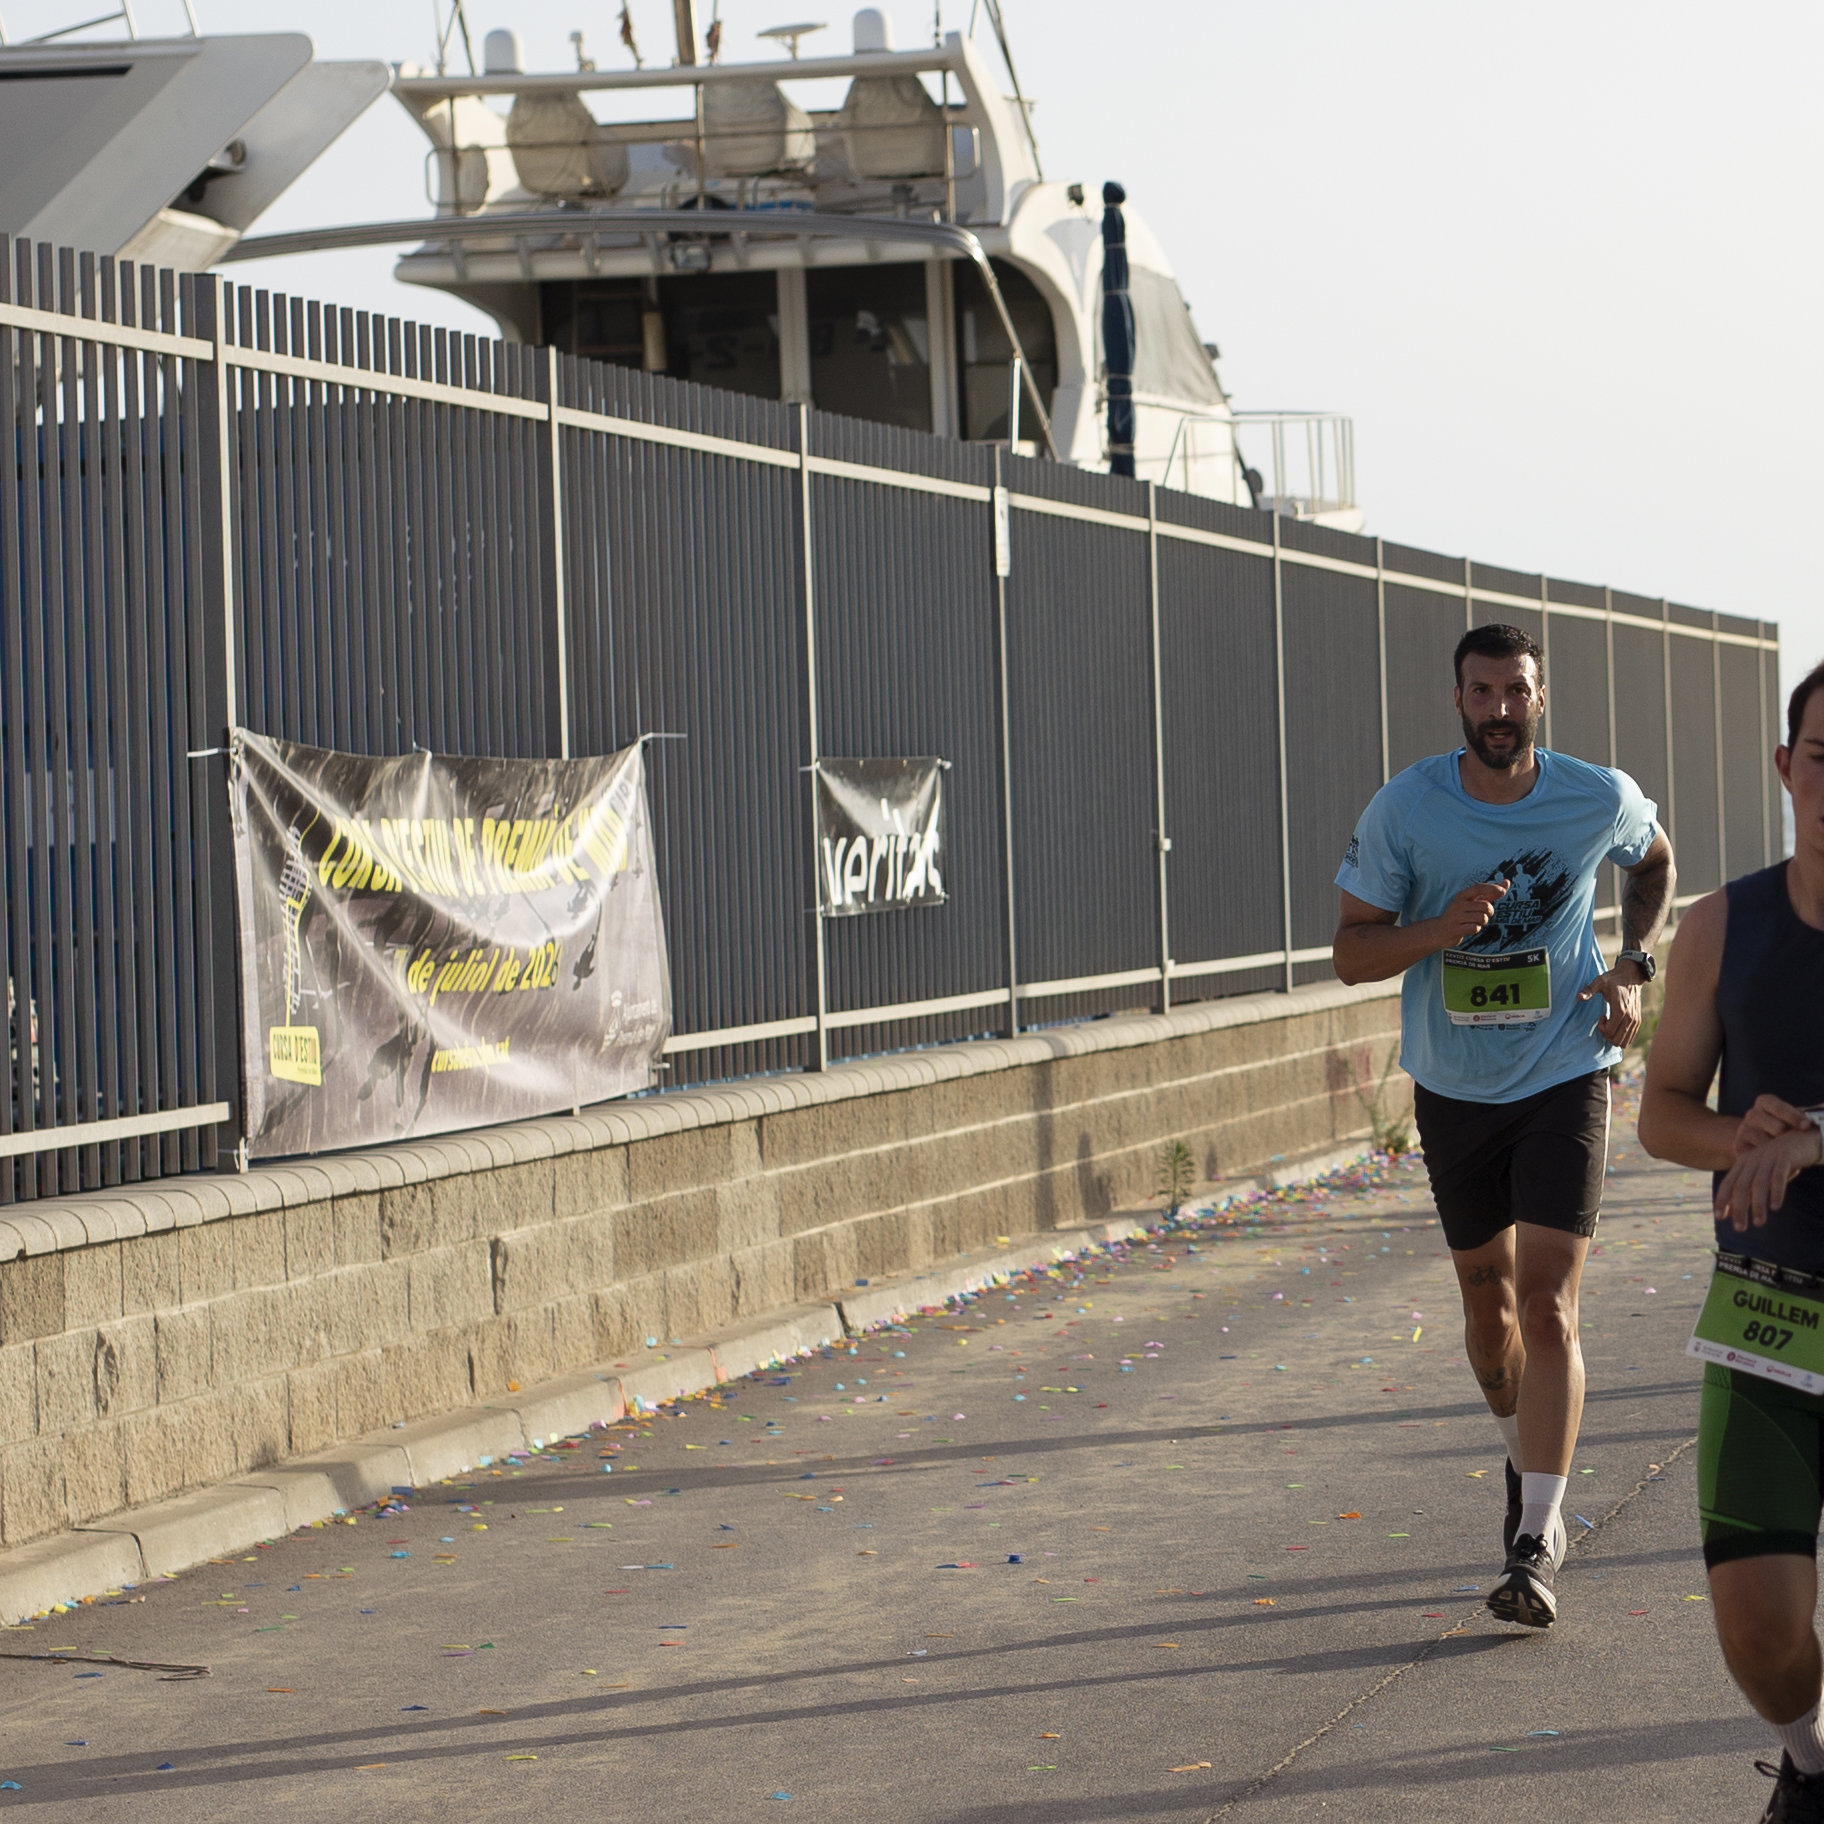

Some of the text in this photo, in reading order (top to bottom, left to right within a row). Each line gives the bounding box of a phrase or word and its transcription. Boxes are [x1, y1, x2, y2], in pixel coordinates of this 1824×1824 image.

[1497, 901, 1539, 910] CURSA
[1527, 954, 1540, 963] 5K
[408, 948, 436, 994] de
[430, 948, 500, 1007] juliol
[493, 946, 521, 992] de
[1470, 983, 1520, 1007] 841
[1733, 1289, 1820, 1330] GUILLEM
[1743, 1320, 1794, 1351] 807
